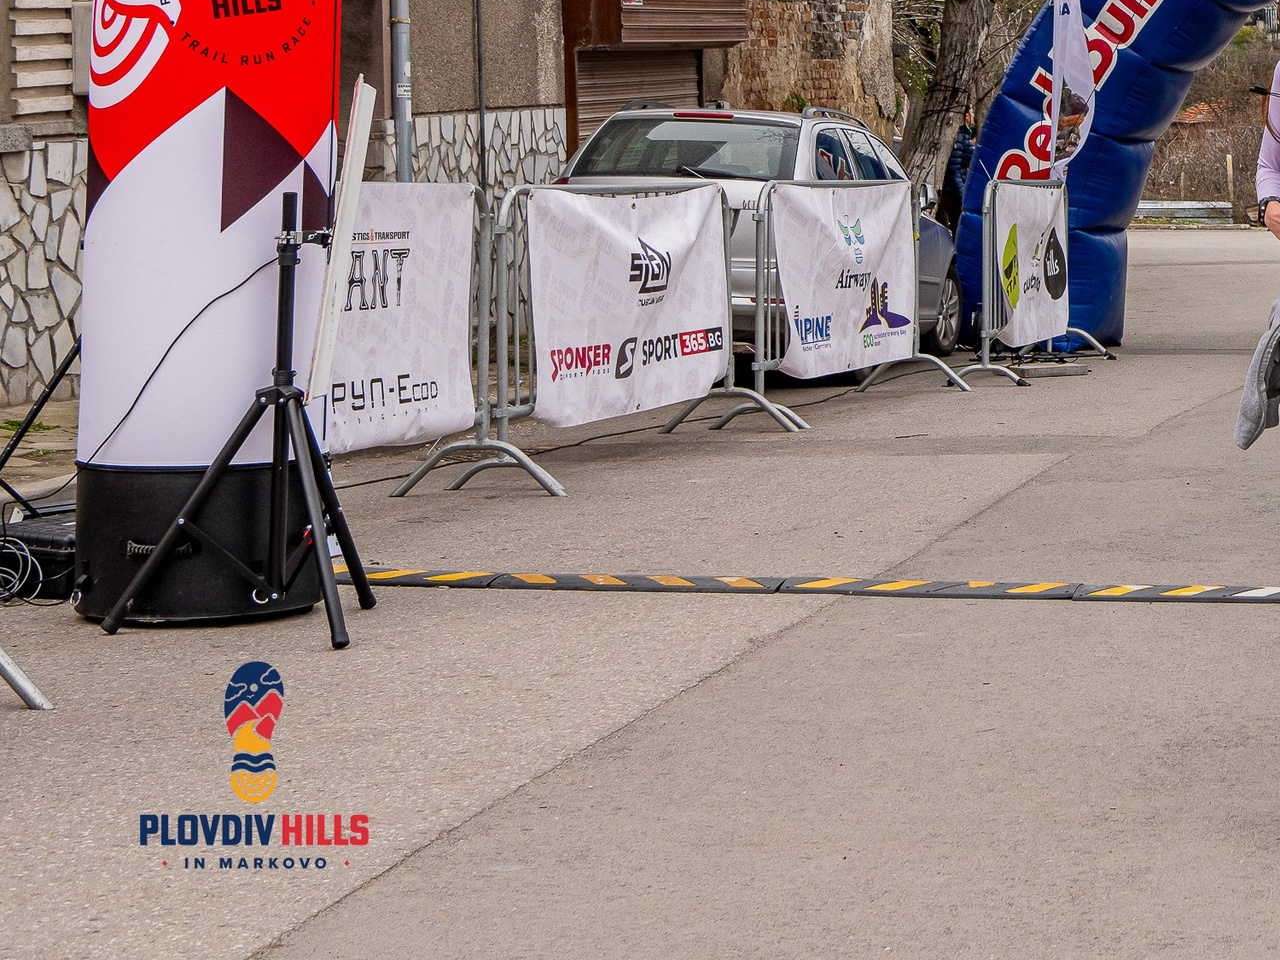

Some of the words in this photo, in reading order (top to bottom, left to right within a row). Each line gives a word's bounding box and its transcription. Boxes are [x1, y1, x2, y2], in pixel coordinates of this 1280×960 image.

[180, 31, 229, 65] TRAIL
[240, 49, 276, 67] RUN
[281, 16, 312, 54] RACE
[550, 343, 611, 382] SPONSER
